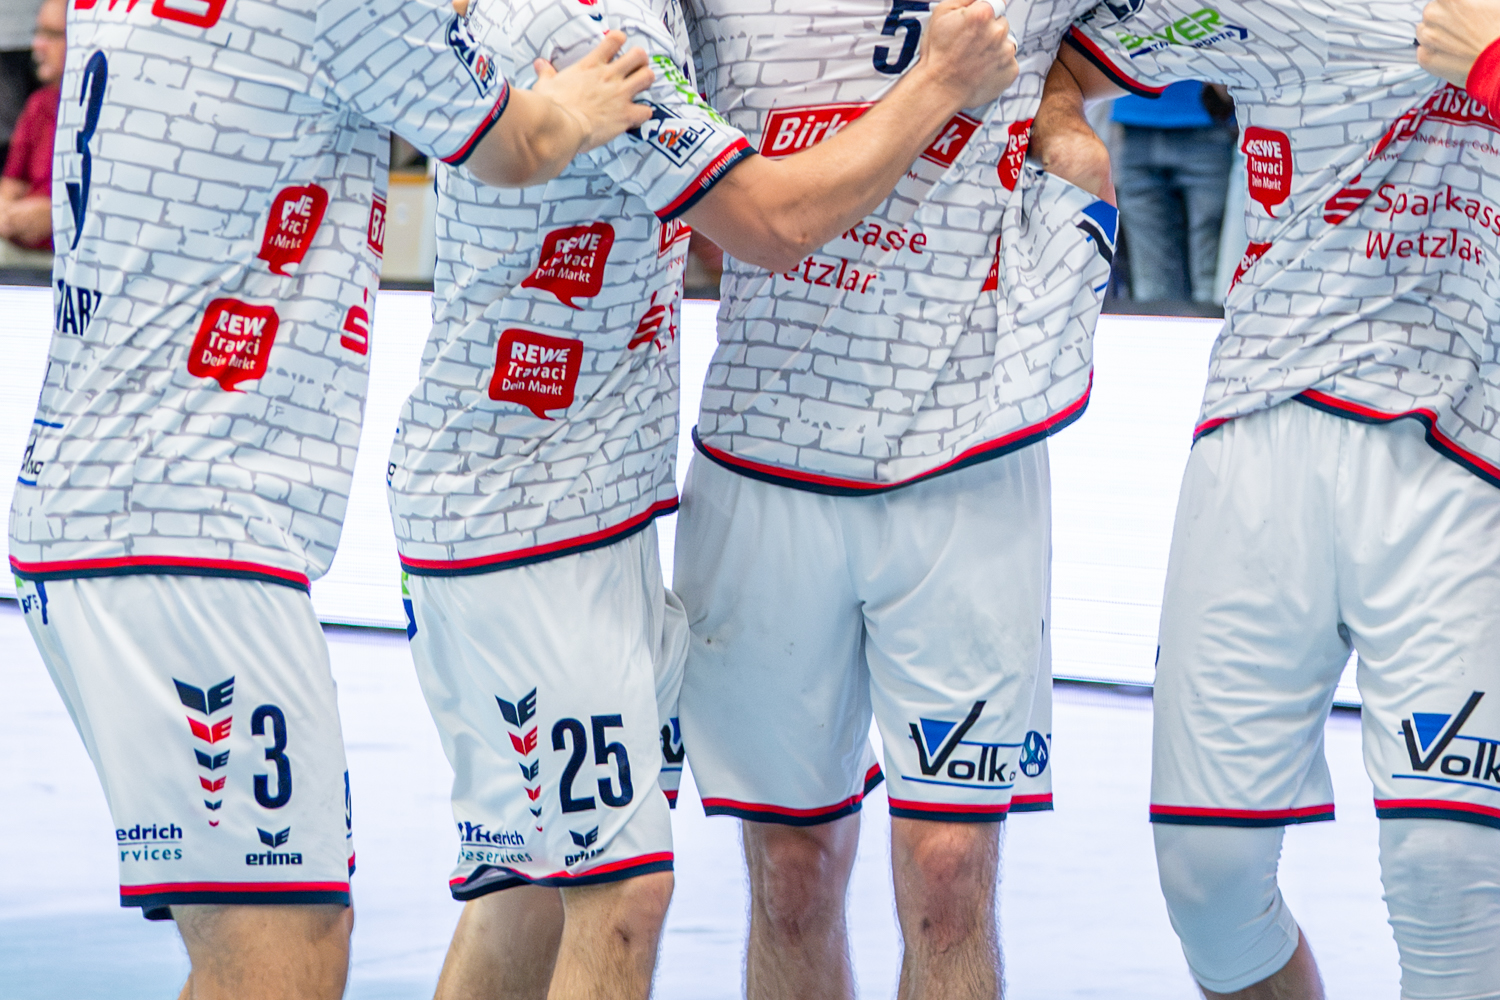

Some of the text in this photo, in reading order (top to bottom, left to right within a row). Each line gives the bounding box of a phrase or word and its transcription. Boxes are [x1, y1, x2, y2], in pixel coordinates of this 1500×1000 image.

[1251, 156, 1283, 176] Travaci
[1366, 229, 1483, 265] Wetzlar
[557, 267, 591, 283] Markt
[215, 309, 266, 338] REW
[510, 341, 571, 364] REWE
[528, 379, 563, 396] Markt
[909, 700, 1006, 783] Volk
[250, 704, 293, 809] 3
[551, 714, 634, 814] 25
[245, 850, 303, 866] erima
